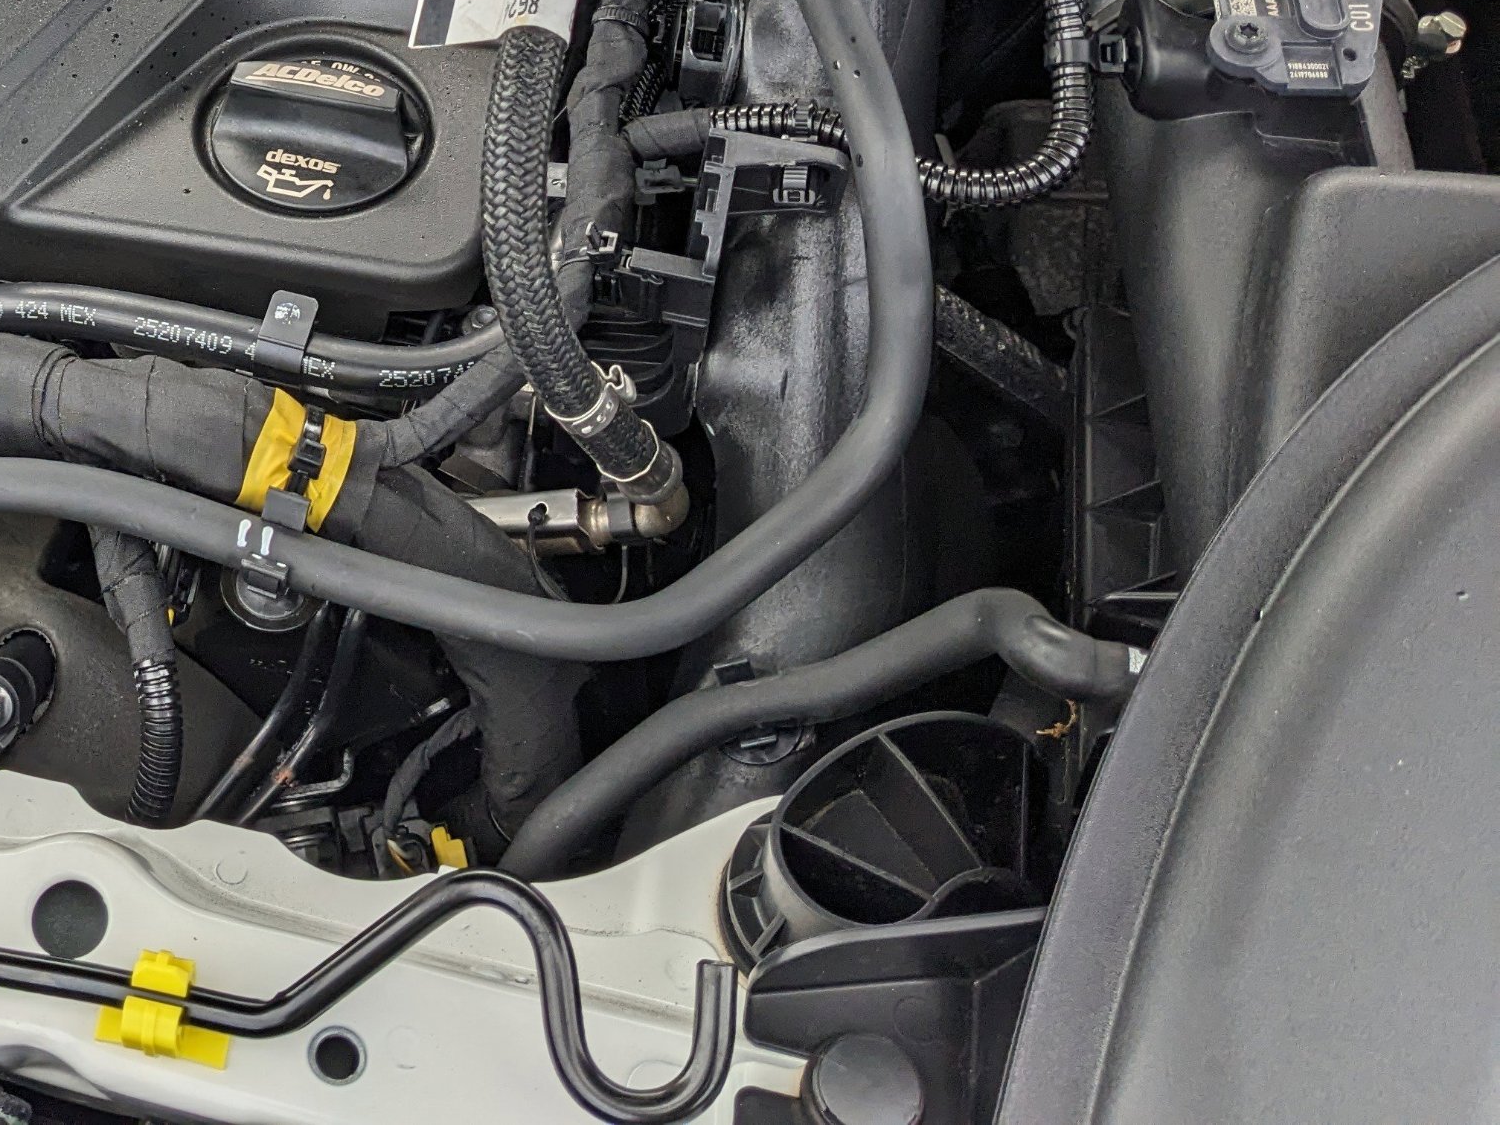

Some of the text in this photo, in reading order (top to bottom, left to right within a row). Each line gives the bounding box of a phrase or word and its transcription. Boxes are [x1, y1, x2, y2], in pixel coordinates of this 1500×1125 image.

[252, 62, 385, 98] ACDelco
[265, 148, 340, 173] dexos
[15, 300, 49, 320] 424
[60, 303, 96, 327] MEX
[133, 316, 234, 355] 25207409
